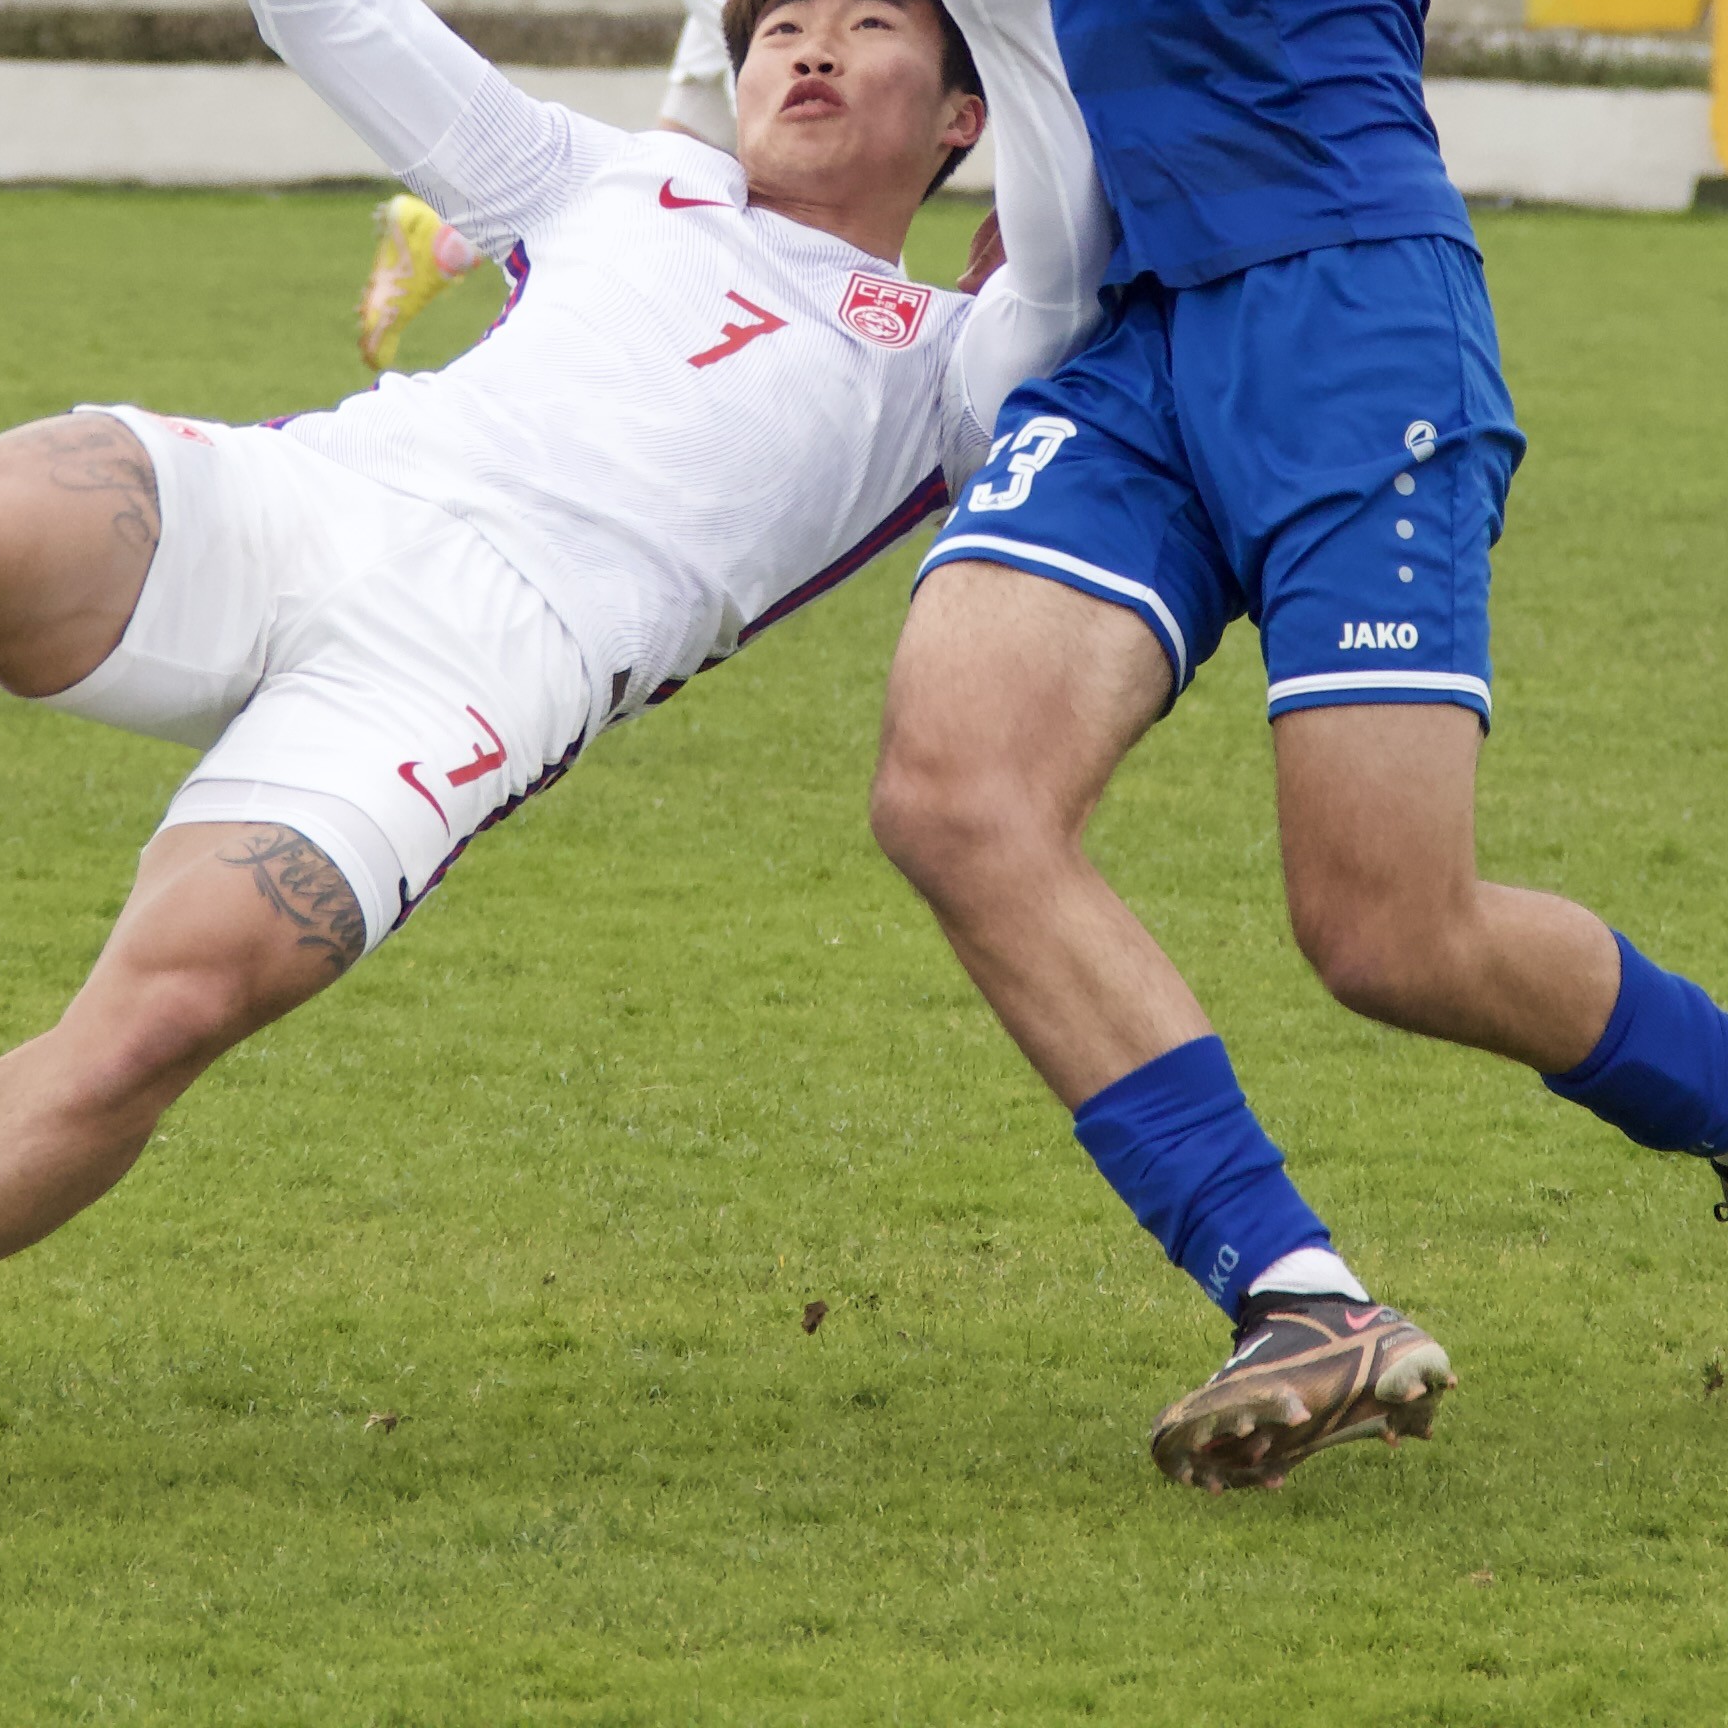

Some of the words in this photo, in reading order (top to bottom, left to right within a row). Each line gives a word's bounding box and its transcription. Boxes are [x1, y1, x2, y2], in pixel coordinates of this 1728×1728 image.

[686, 289, 791, 370] 7
[857, 281, 920, 308] CFA
[943, 415, 1078, 529] 3
[1338, 622, 1419, 650] JAKO
[445, 704, 508, 788] 7
